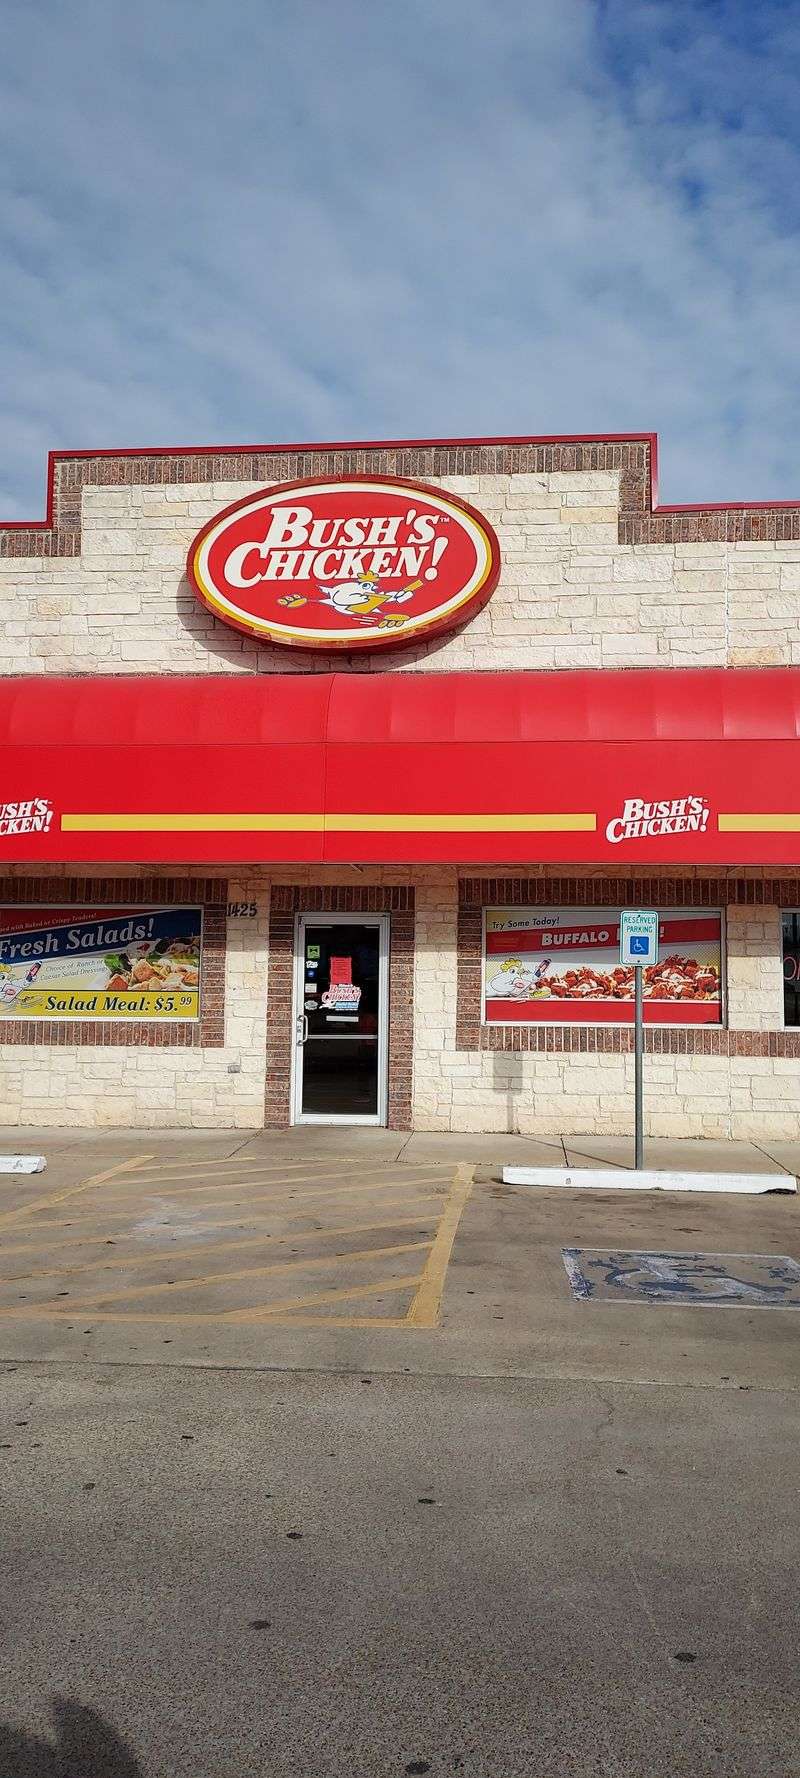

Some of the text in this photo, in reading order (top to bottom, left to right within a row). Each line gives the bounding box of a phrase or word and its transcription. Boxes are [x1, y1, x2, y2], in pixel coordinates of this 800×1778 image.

[264, 506, 439, 549] BUSH'S
[223, 536, 448, 588] CHICKEN!
[622, 795, 703, 821] BUSH'S
[606, 808, 709, 843] CHICKEN!
[225, 902, 257, 918] 1425
[25, 920, 43, 929] Baked
[491, 916, 560, 930] Try Some Today!
[623, 916, 656, 925] RESERVED
[626, 925, 653, 934] PARKING
[0, 918, 155, 959] Fresh Salads!
[541, 930, 610, 946] BUFFALO
[76, 959, 96, 968] Ranch
[62, 969, 79, 978] Salad
[45, 996, 97, 1012] Salad
[102, 996, 151, 1012] Meal:
